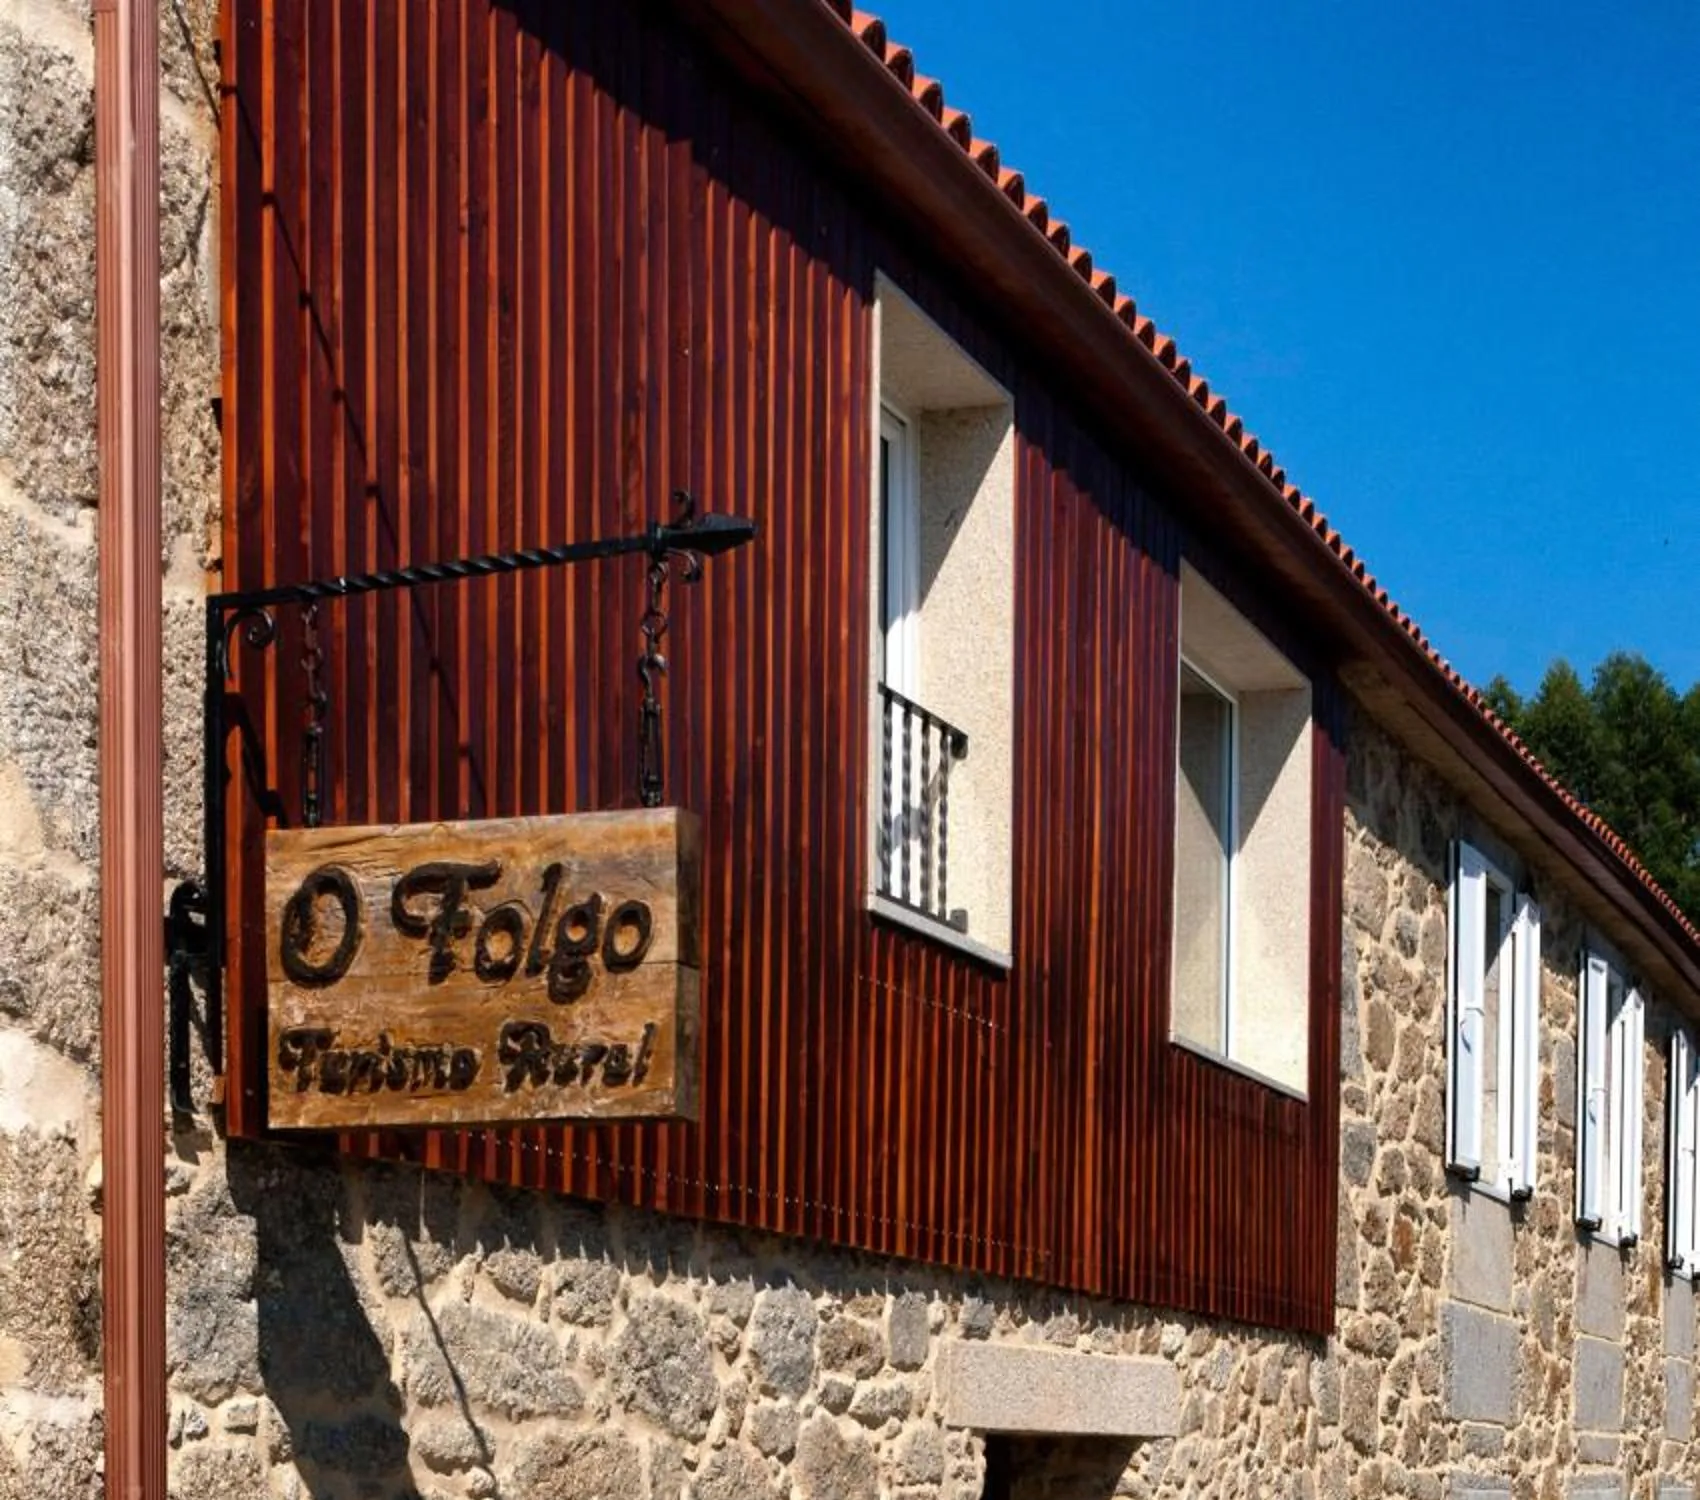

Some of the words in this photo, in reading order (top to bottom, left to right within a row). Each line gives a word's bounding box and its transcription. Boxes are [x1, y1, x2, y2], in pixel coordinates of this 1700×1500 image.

[281, 864, 362, 988] O
[390, 860, 653, 1004] Folgo
[278, 1027, 482, 1096] Turismo
[499, 1021, 657, 1093] Rural
